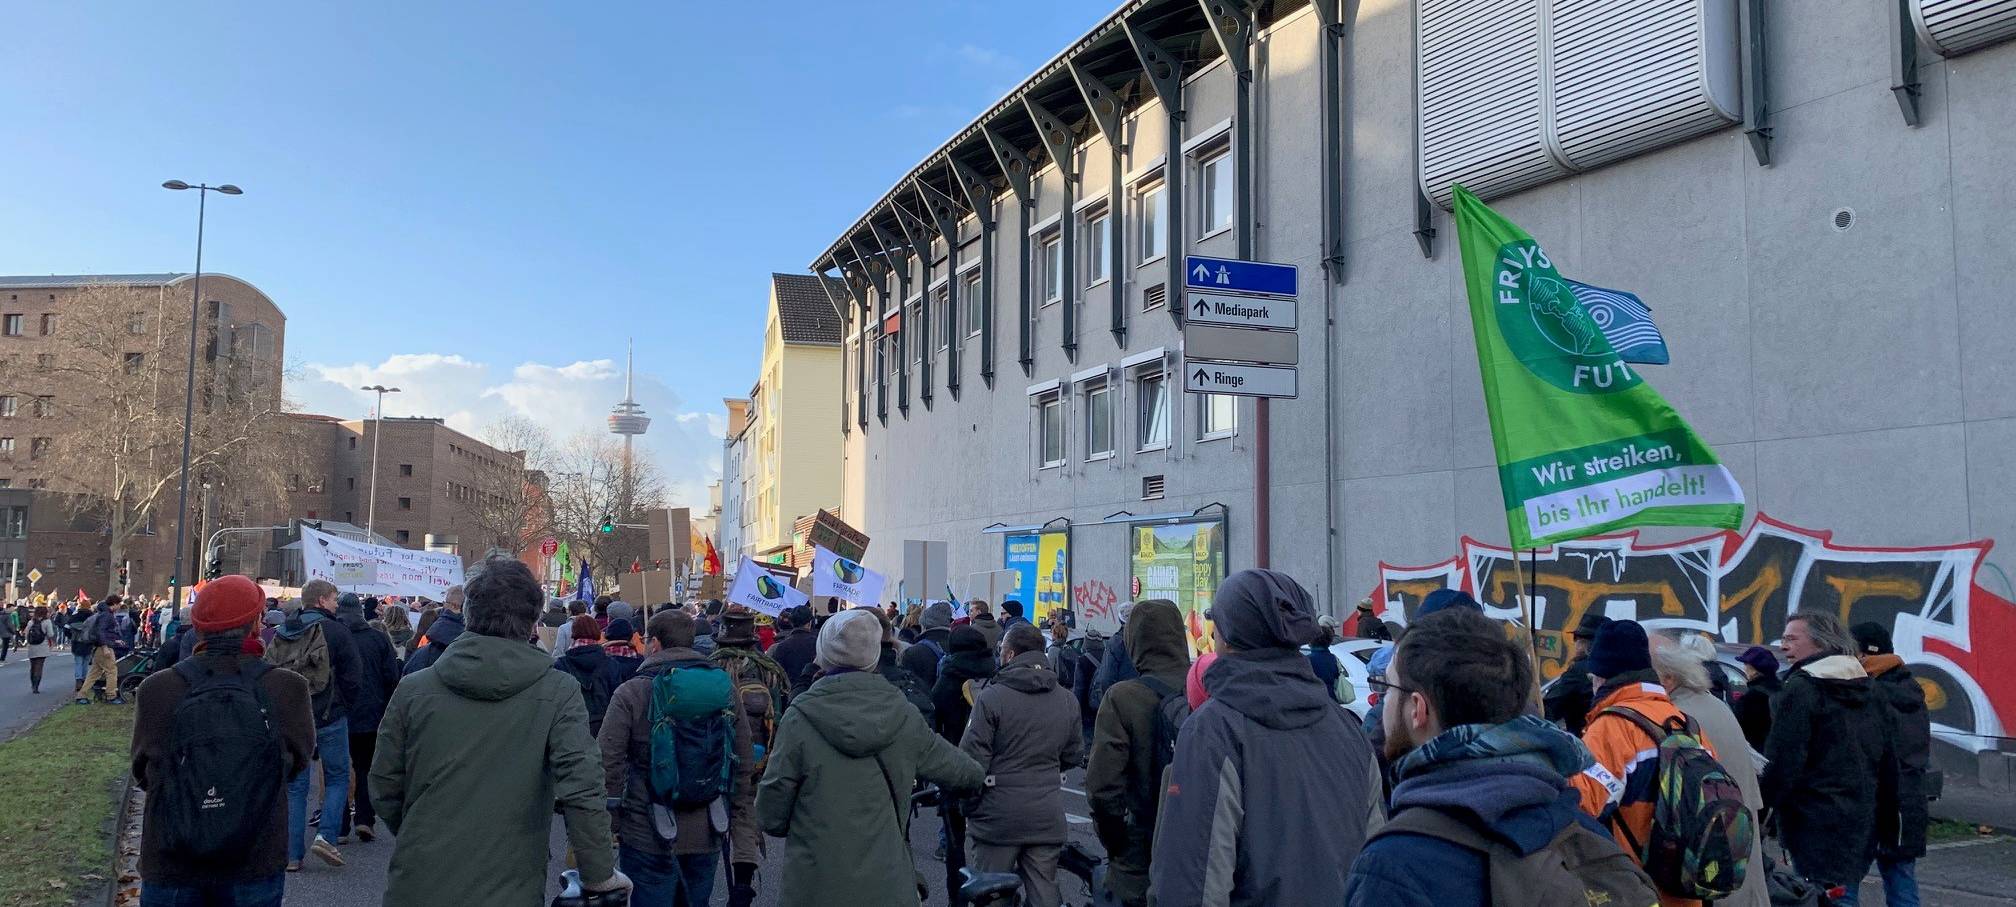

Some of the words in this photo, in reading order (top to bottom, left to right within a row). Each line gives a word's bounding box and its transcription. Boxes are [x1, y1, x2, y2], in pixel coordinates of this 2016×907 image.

[1500, 245, 1551, 304] FRIYS
[1214, 302, 1270, 320] Mediapark
[1214, 371, 1244, 388] Ringe
[1573, 360, 1632, 388] FUT
[1531, 462, 1576, 487] Wir
[1584, 443, 1682, 477] streiken,
[1537, 504, 1570, 527] bis
[1577, 494, 1610, 518] Ihr
[1615, 473, 1706, 509] handelt!
